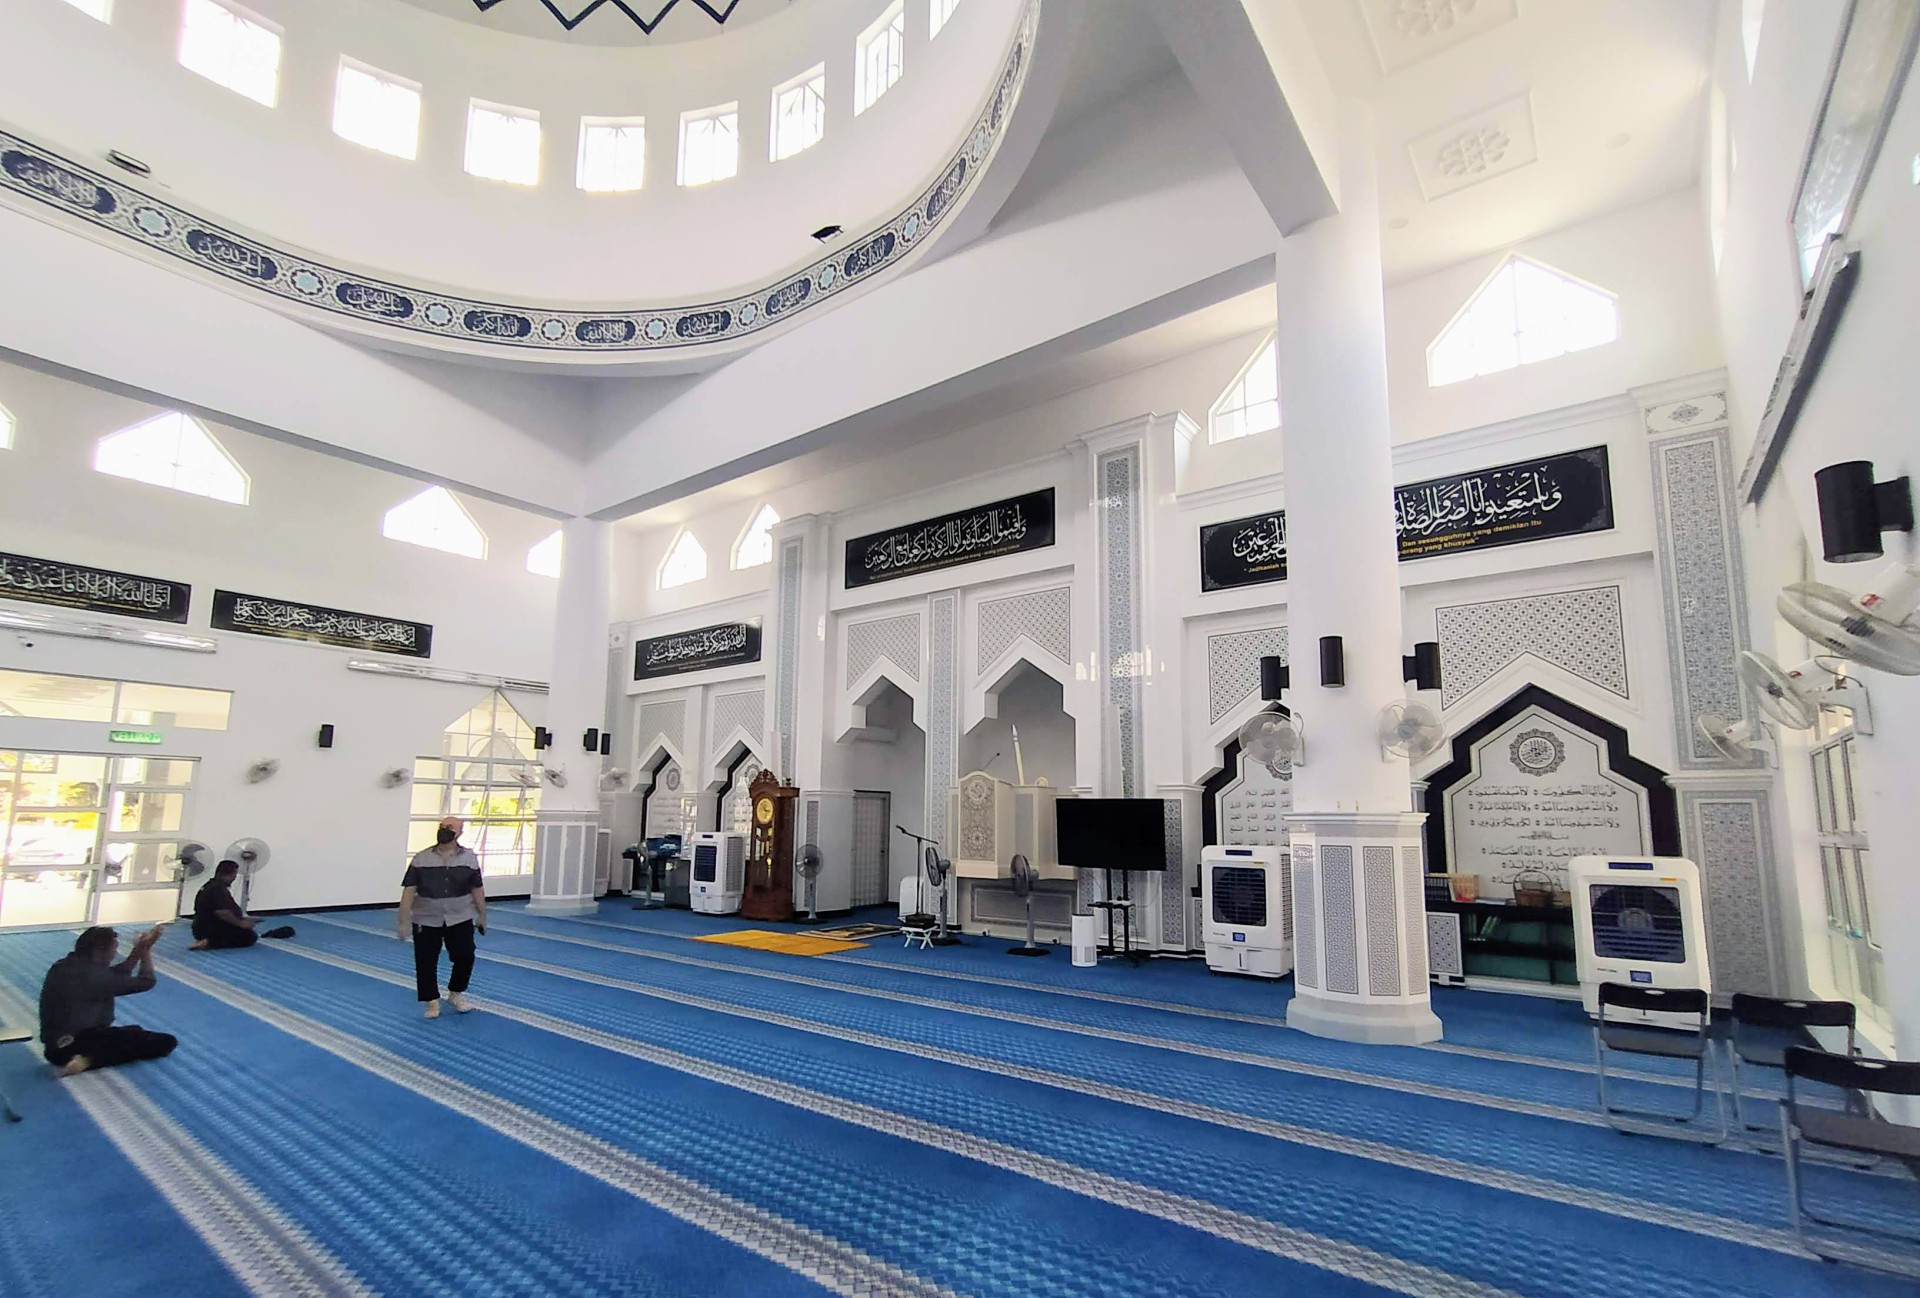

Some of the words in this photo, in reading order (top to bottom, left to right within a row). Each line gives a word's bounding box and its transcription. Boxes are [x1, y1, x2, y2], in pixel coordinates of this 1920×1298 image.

[1402, 540, 1416, 548] Dan
[1473, 526, 1492, 537] yang
[1424, 543, 1442, 553] yang
